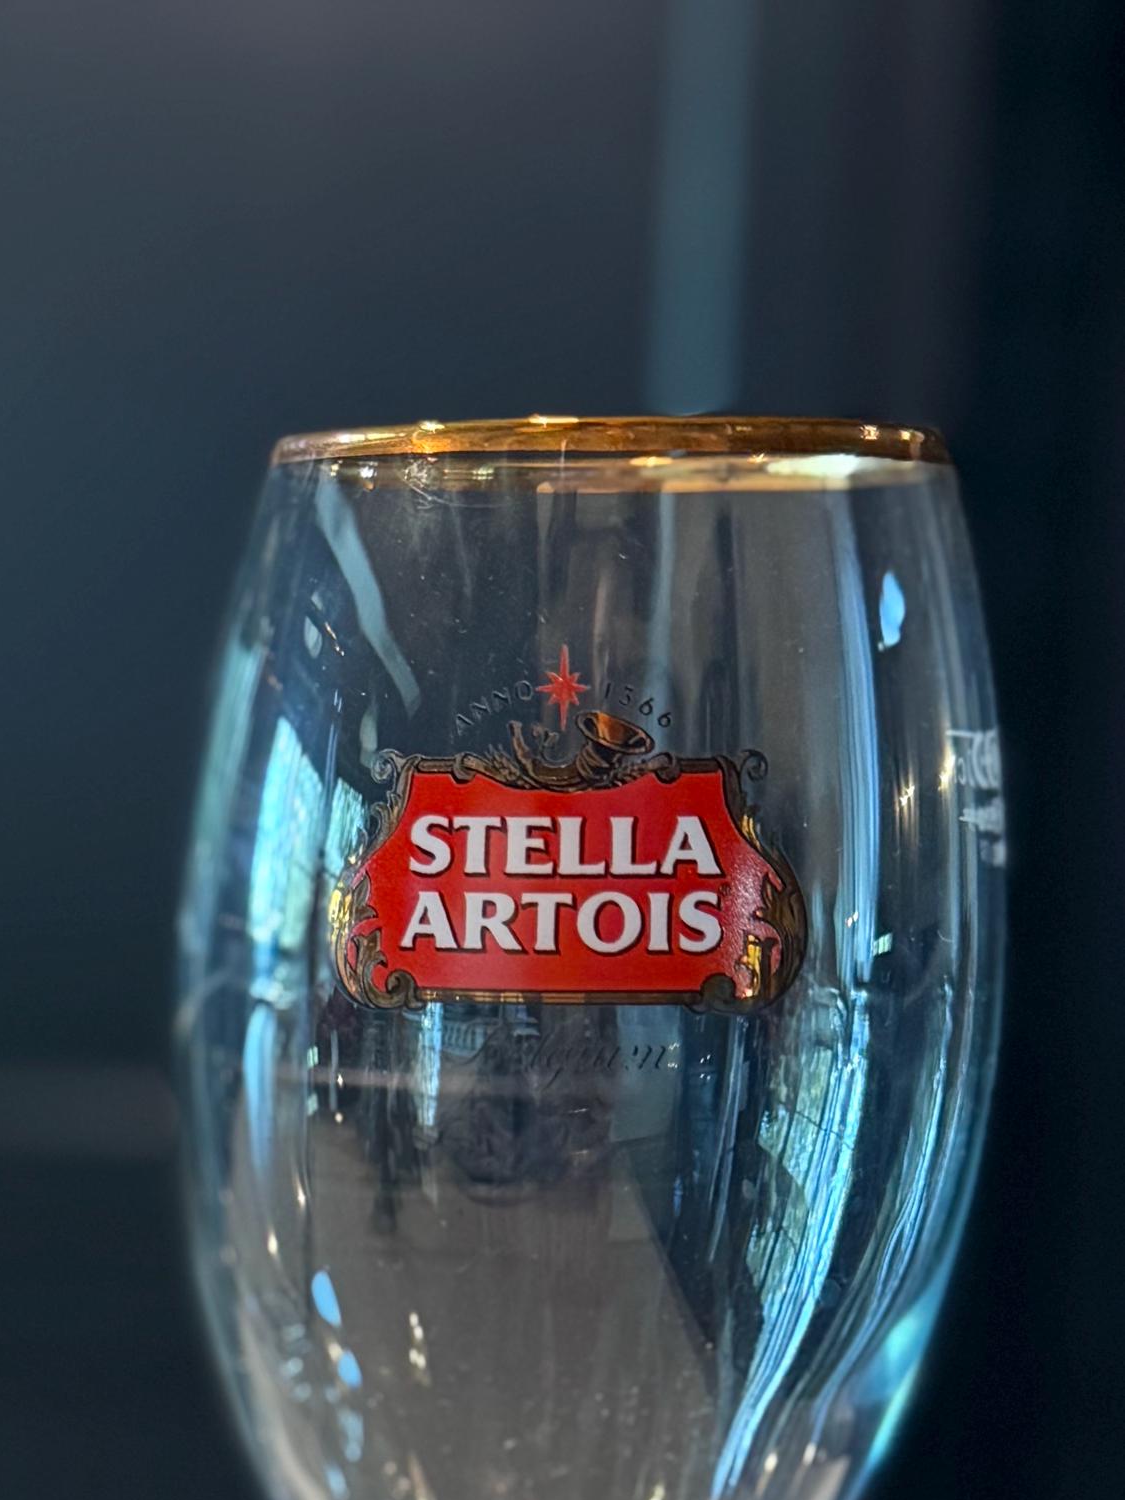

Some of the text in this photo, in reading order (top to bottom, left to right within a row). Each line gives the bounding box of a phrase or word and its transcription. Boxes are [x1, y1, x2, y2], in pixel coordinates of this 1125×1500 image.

[454, 679, 672, 736] ANNO 1366
[408, 814, 723, 877] STELLA
[399, 890, 724, 955] ARTOIS
